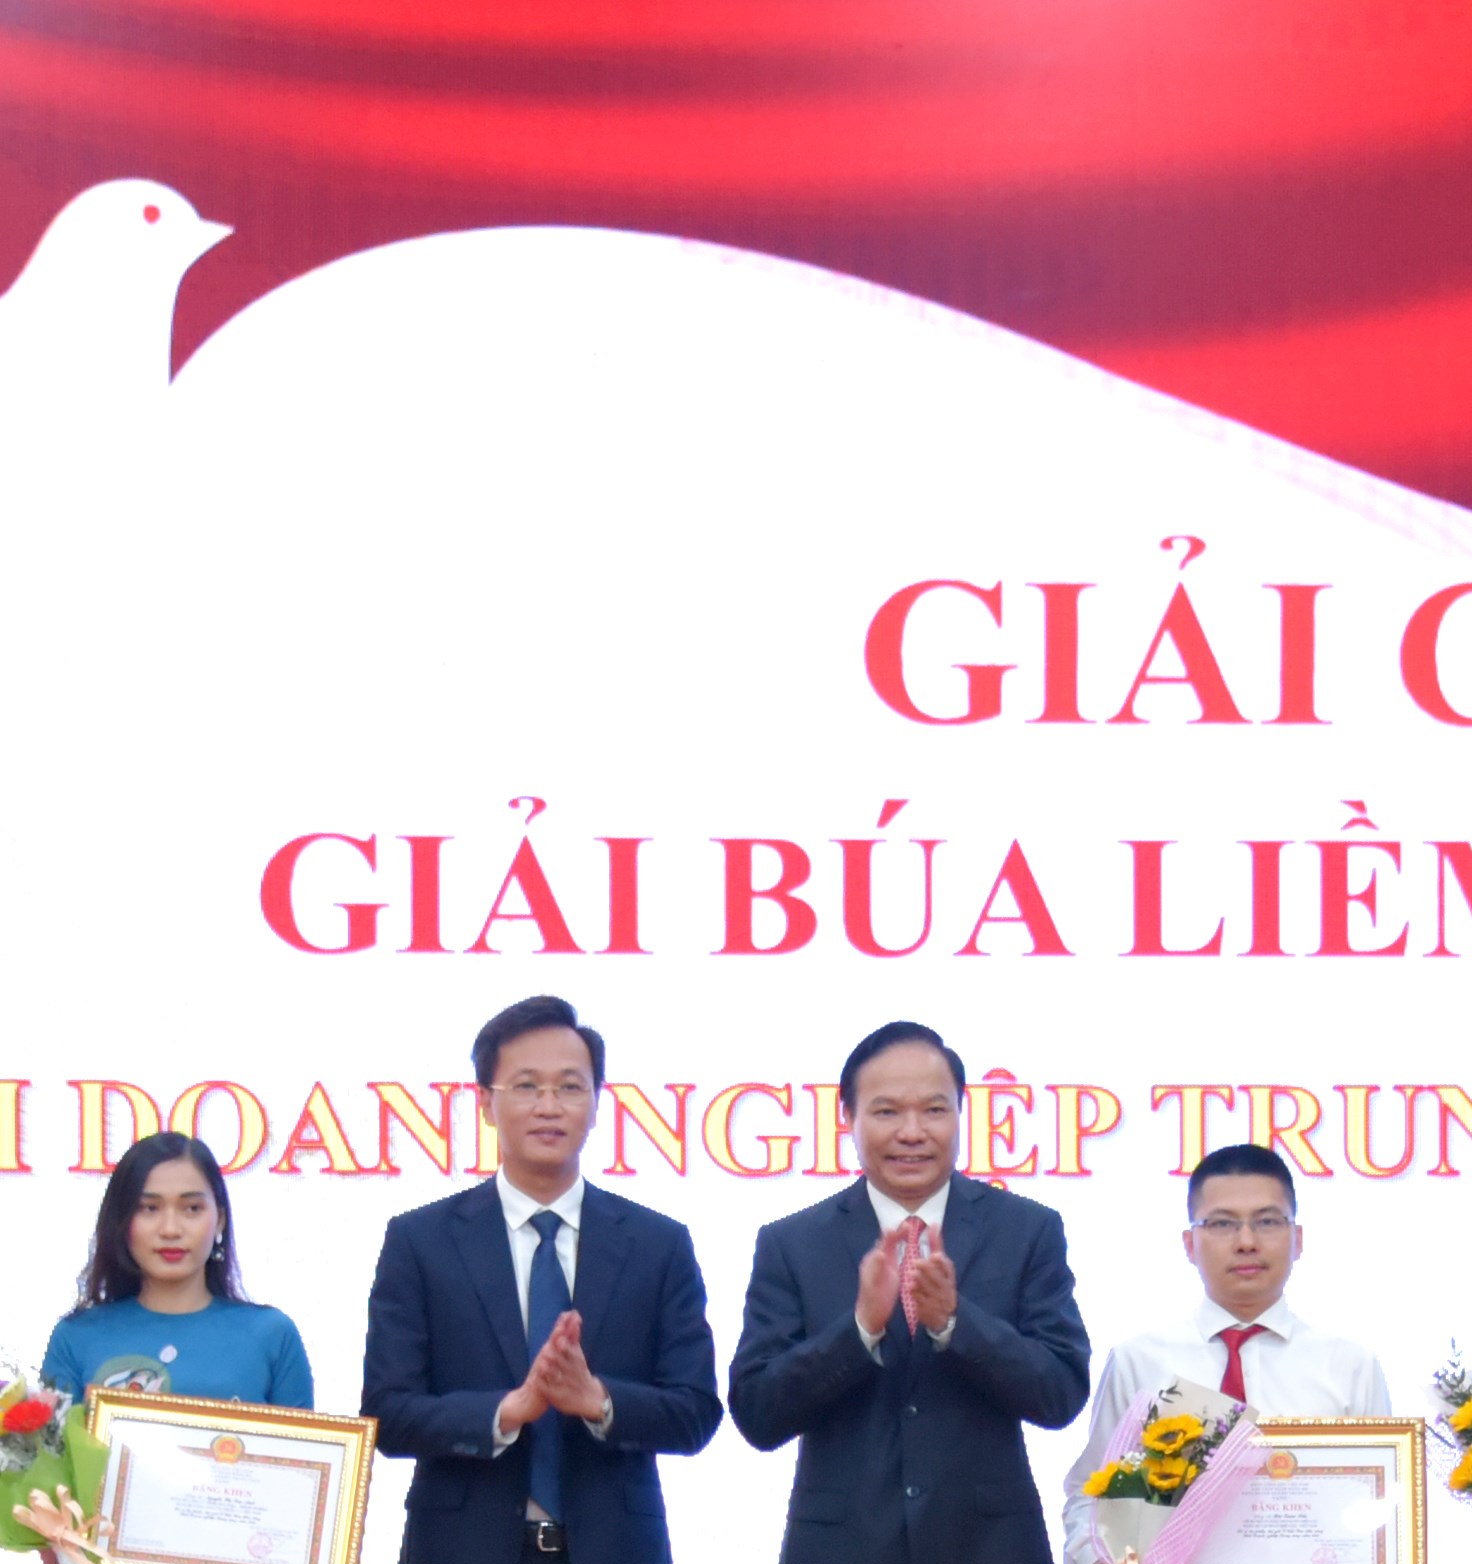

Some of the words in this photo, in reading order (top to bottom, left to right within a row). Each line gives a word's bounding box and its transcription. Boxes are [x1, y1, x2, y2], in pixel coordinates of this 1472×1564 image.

[863, 534, 1332, 727] GIẢI
[259, 795, 653, 956] GIẢI
[710, 799, 1074, 958] BÚA
[1282, 1503, 1313, 1512] KHEN
